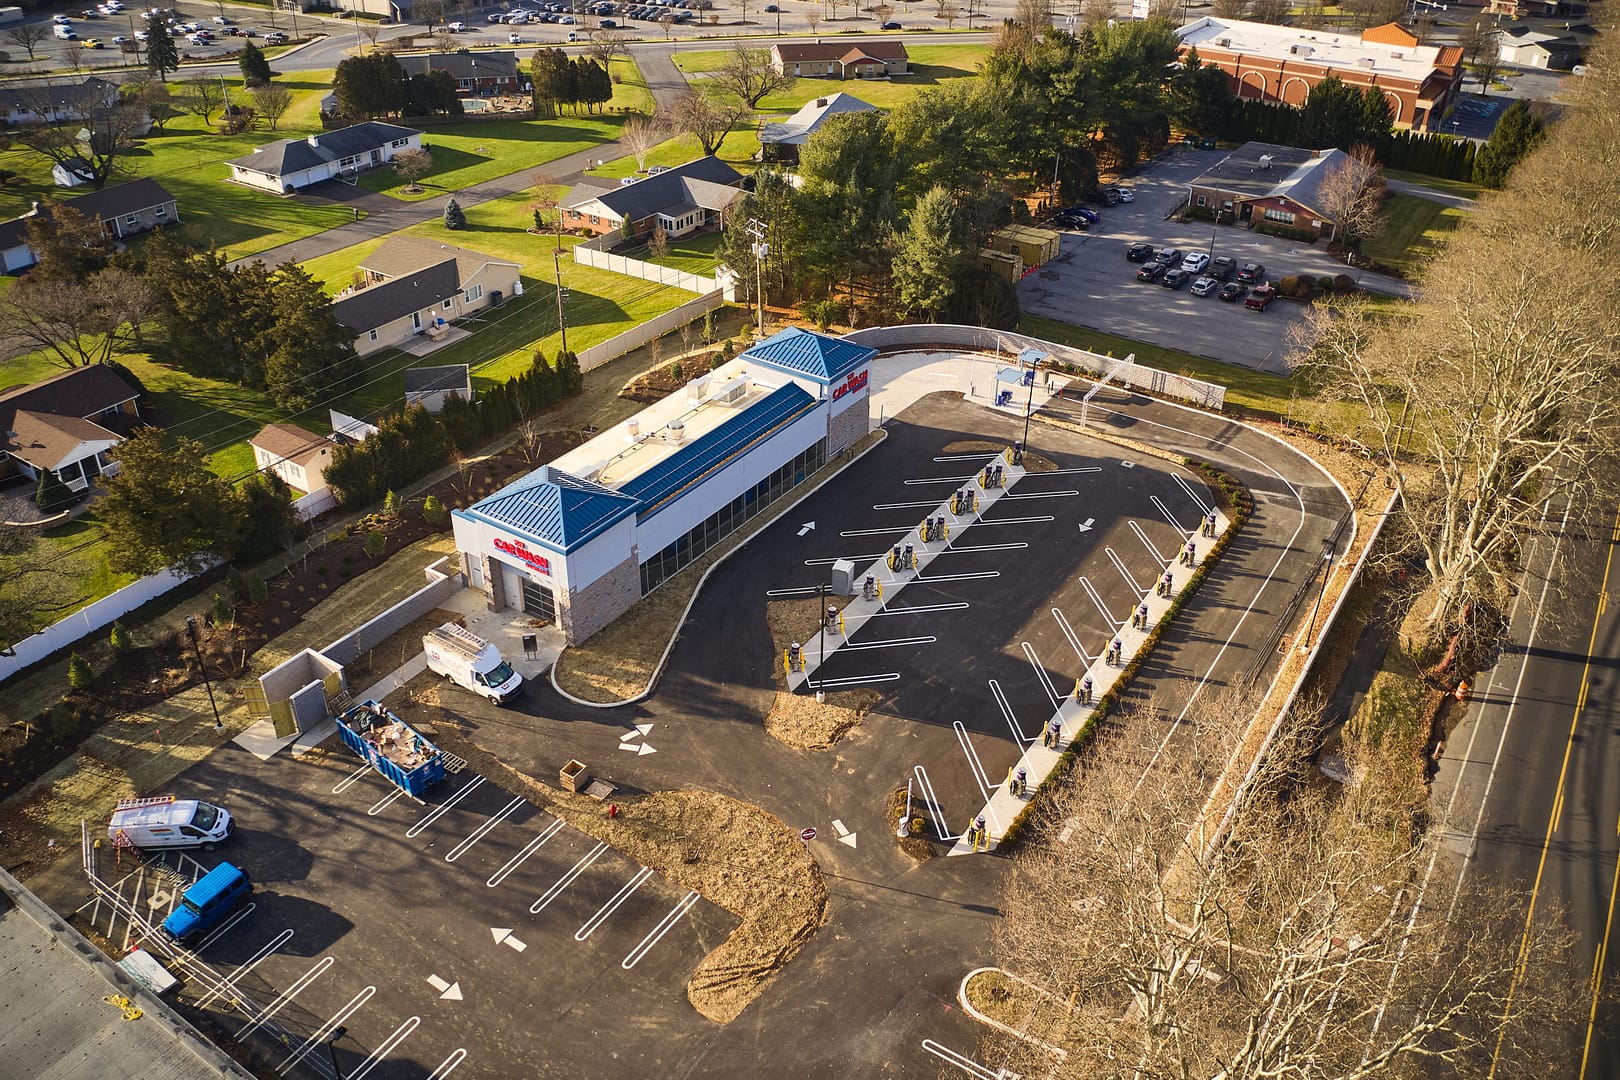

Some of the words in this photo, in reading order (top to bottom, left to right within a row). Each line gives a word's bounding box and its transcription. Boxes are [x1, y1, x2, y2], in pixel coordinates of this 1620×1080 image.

[833, 383, 848, 400] CAR
[848, 369, 868, 390] WASH
[493, 537, 517, 556] CAR
[515, 546, 549, 569] WASH
